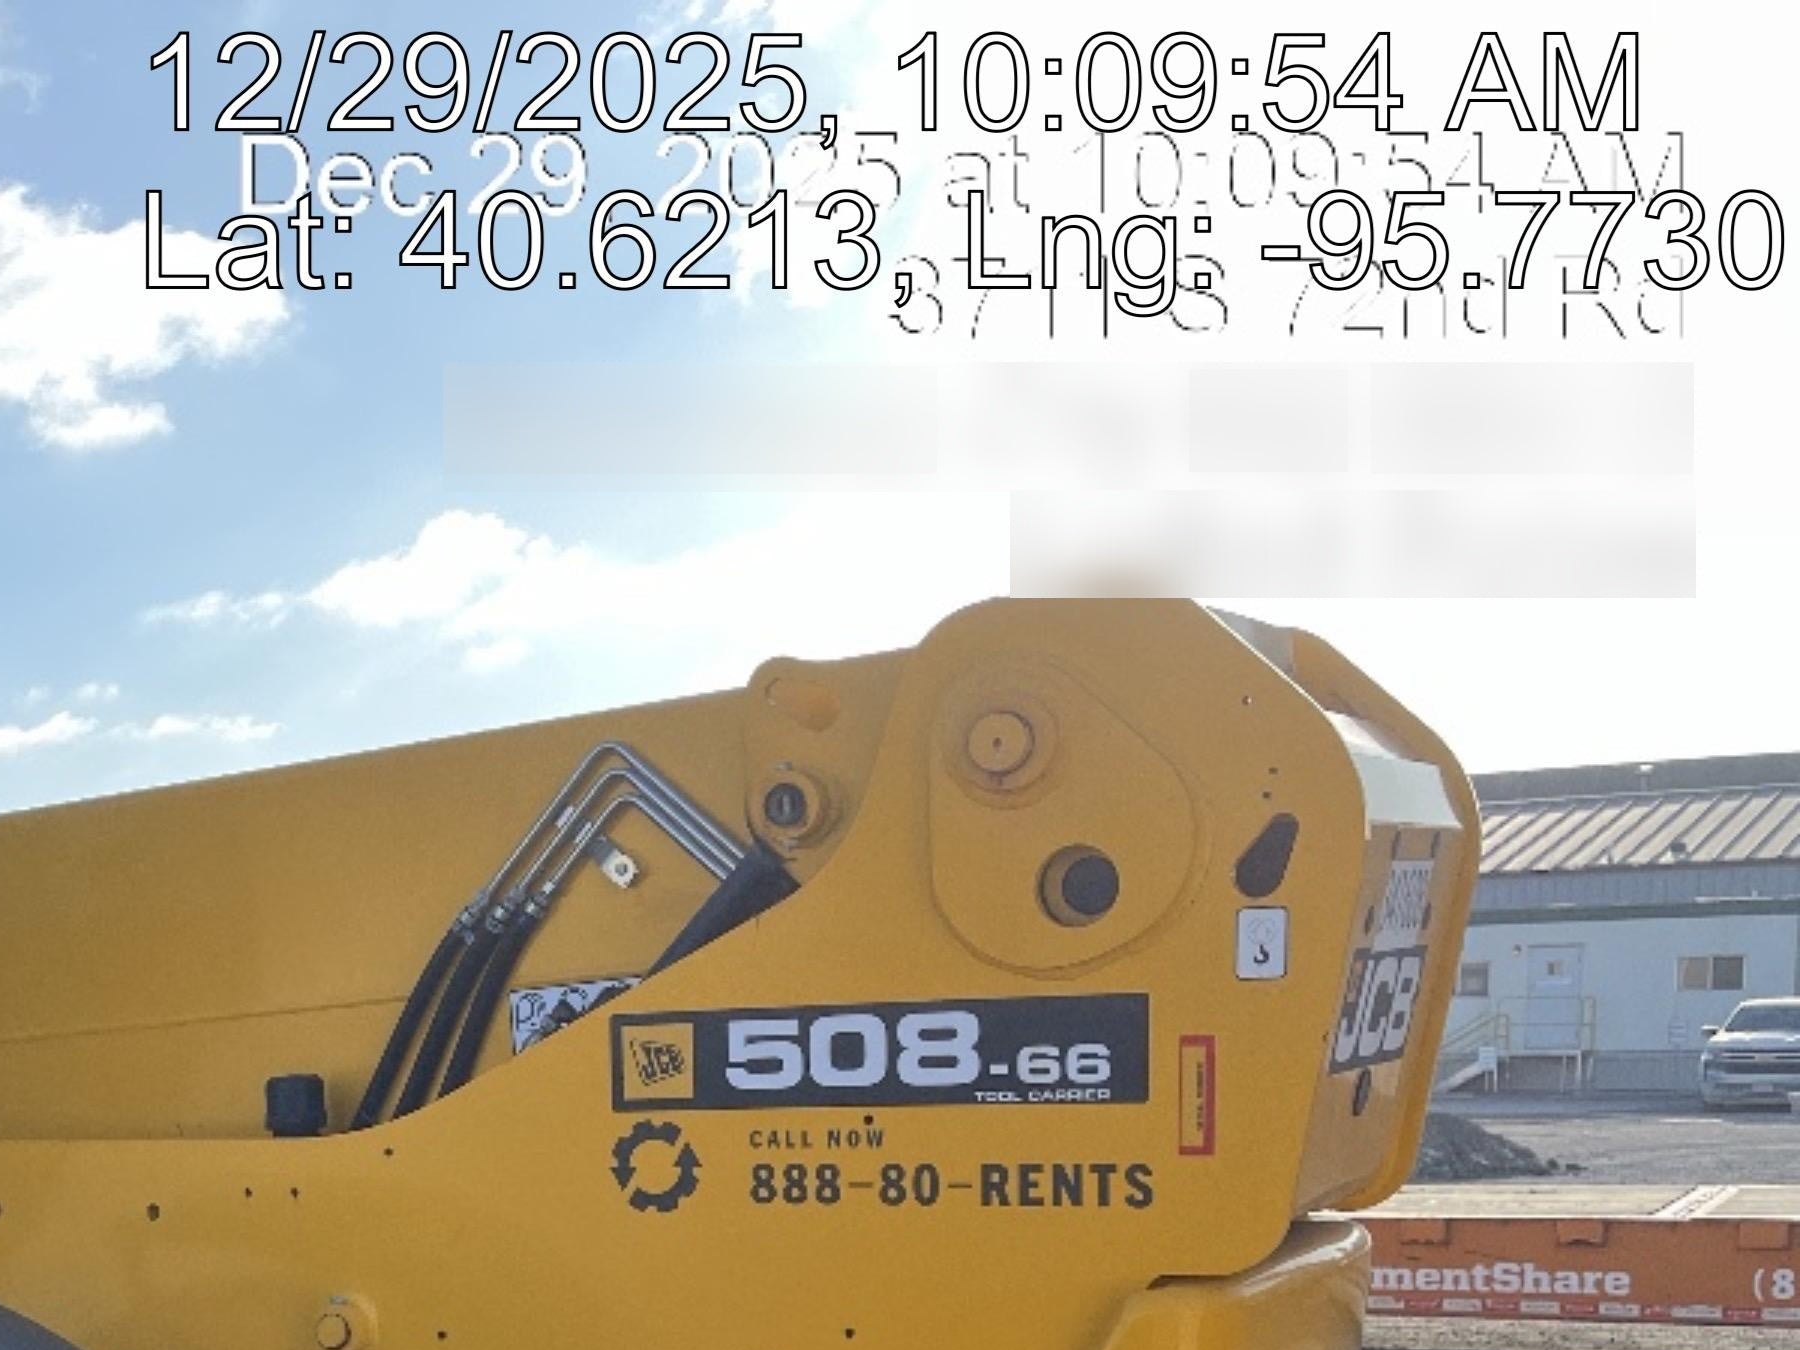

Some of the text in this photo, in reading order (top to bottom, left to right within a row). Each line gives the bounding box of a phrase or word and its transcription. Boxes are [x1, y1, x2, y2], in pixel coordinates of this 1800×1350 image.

[1334, 955, 1422, 1063] JCB
[725, 1010, 1112, 1091] 508-66
[749, 1129, 884, 1150] CALL NOW
[749, 1162, 1155, 1209] 888-80-RENTS
